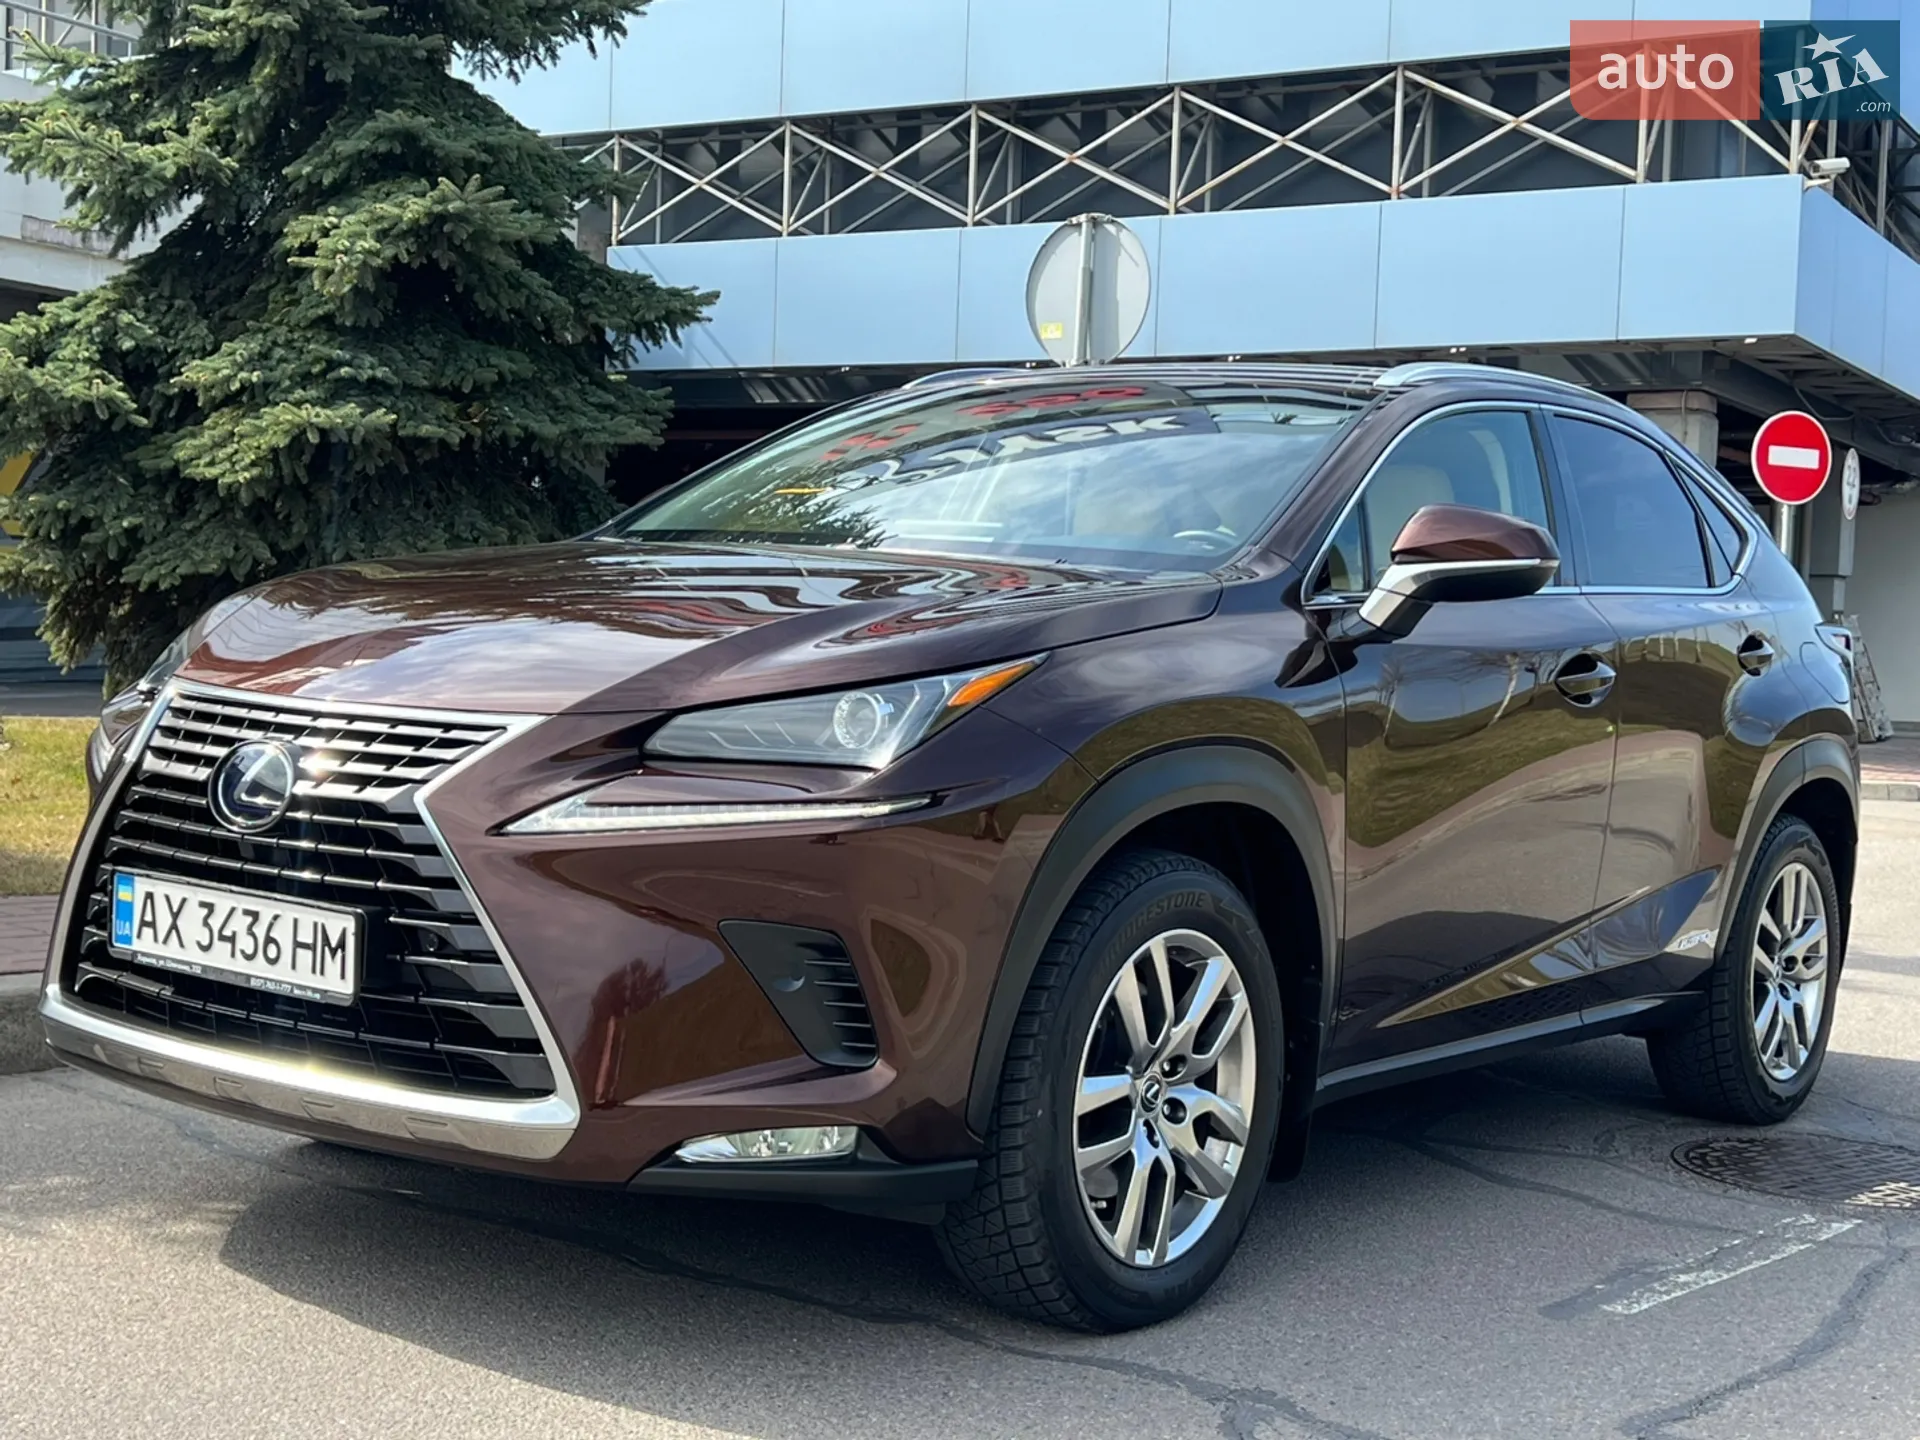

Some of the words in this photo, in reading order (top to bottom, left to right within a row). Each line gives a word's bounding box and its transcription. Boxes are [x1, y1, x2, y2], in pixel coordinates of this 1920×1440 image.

[116, 919, 131, 936] UA
[136, 890, 188, 949] AX
[195, 900, 282, 967] 3436
[290, 916, 348, 981] HM
